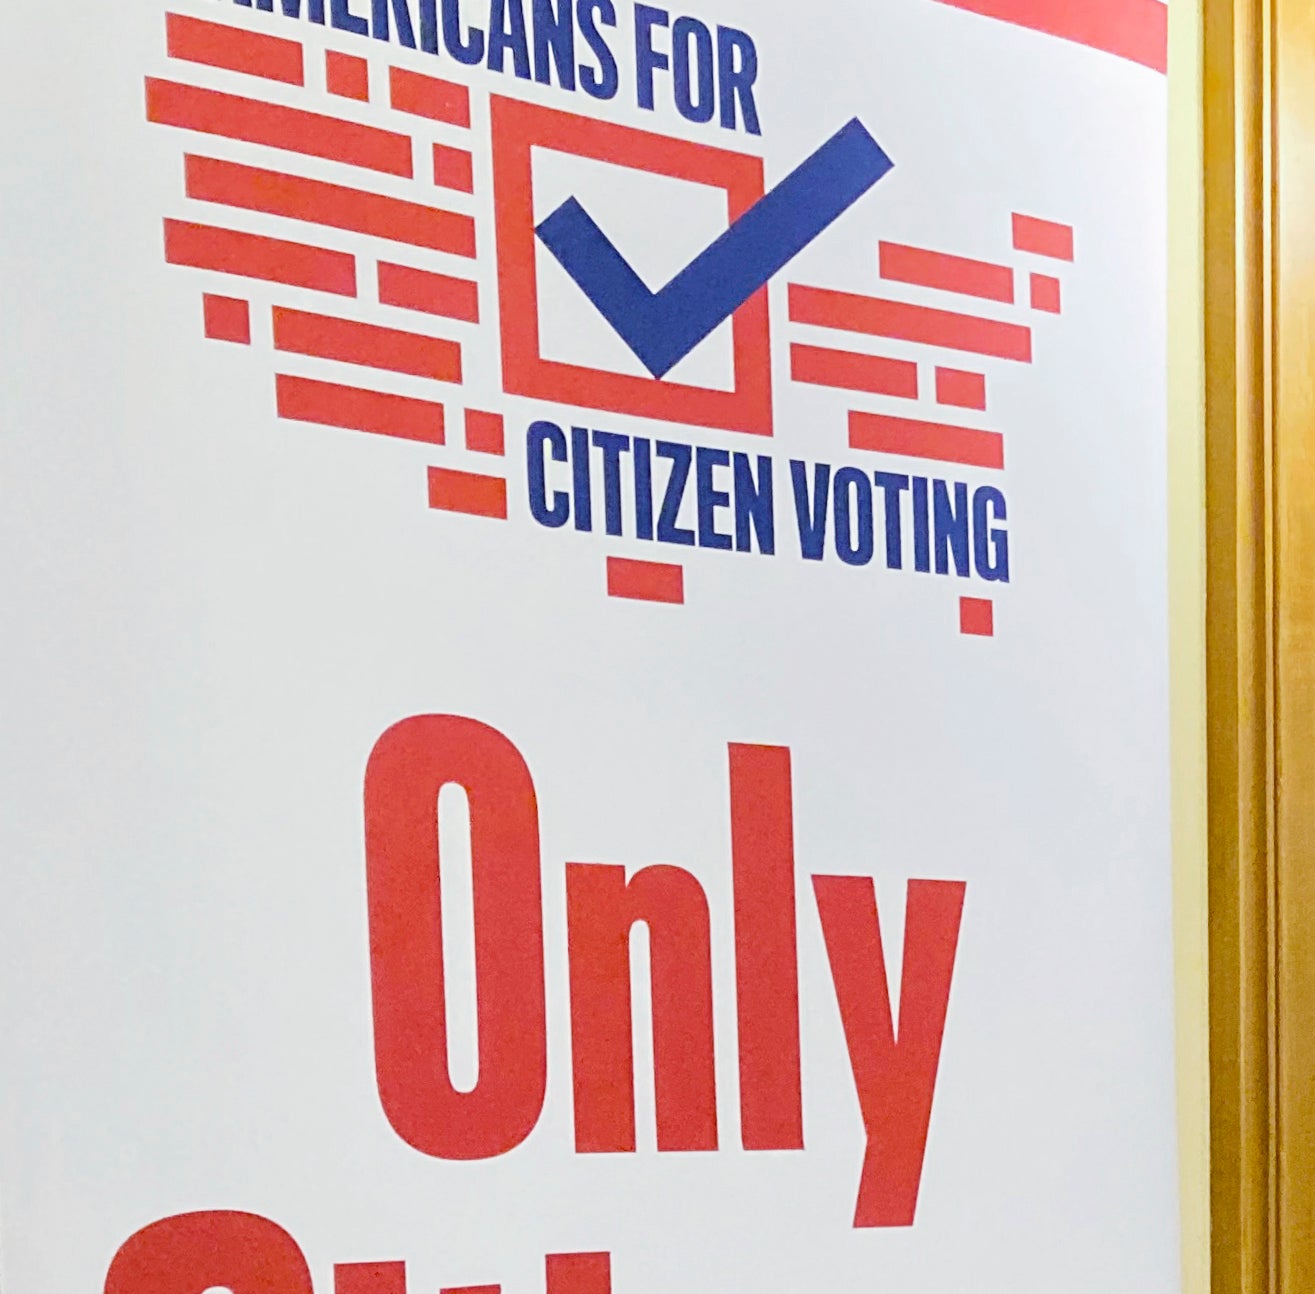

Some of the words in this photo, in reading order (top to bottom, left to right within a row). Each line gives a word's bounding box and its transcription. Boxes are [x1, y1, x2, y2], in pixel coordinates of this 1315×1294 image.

[634, 2, 762, 136] FOR
[527, 421, 775, 555] CITIZEN
[789, 459, 1009, 583] VOTING
[363, 713, 967, 1228] Only
